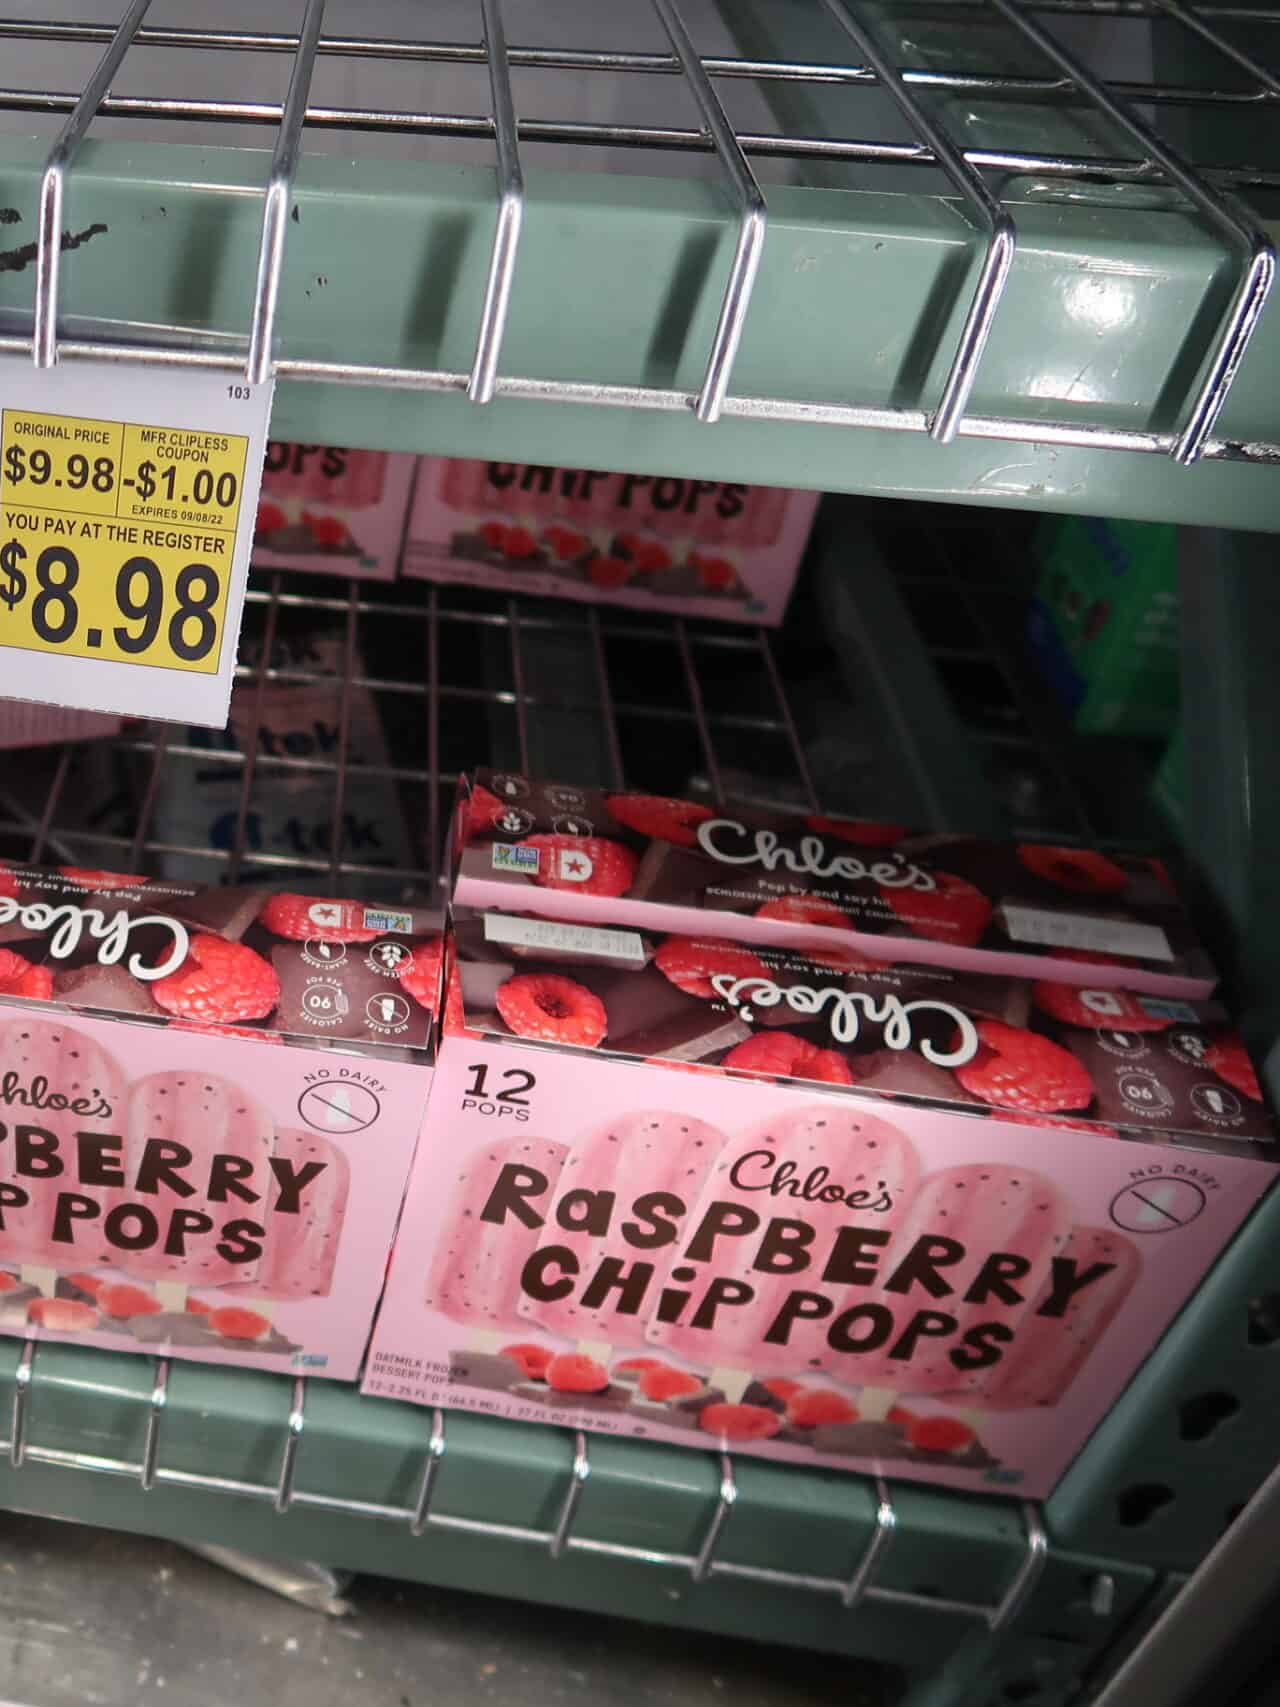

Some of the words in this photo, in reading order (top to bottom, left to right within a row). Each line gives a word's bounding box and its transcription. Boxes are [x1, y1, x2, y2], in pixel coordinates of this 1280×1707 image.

[227, 385, 250, 400] 103
[14, 422, 70, 440] ORIGINAL
[74, 430, 110, 445] PRICE
[141, 430, 166, 444] MFR
[169, 433, 228, 452] CLIPLESS
[157, 446, 209, 463] COUPON
[4, 444, 114, 493] $9.98
[123, 460, 237, 508] -$1.00
[132, 504, 178, 521] EXPIRES
[181, 510, 223, 525] 09/08/22
[5, 512, 39, 532] YOU
[44, 517, 77, 537] PAY
[80, 522, 106, 539] AT
[106, 525, 138, 544] THE
[143, 529, 225, 554] REGISTER
[697, 819, 936, 891] Chloe's
[35, 880, 58, 892] say
[63, 883, 89, 895] and
[94, 887, 111, 899] by
[115, 890, 142, 902] Pop
[758, 879, 785, 893] Pop
[789, 883, 807, 897] by
[817, 889, 840, 900] and
[848, 970, 867, 982] by
[872, 974, 901, 986] Pop
[310, 995, 331, 1009] 90
[711, 975, 978, 1067] Chloe's
[303, 1068, 331, 1085] NO
[339, 1068, 388, 1093] DAIRY
[464, 1063, 537, 1106] 12
[461, 1099, 530, 1122] POPS
[729, 1149, 895, 1213] Chloe's
[1129, 1164, 1163, 1180] NO
[1173, 1164, 1220, 1190] DAIRY
[52, 1191, 267, 1266] POPS
[764, 1290, 1014, 1373] POPS
[375, 1351, 423, 1368] OATMILK
[372, 1363, 421, 1382] DESSERT
